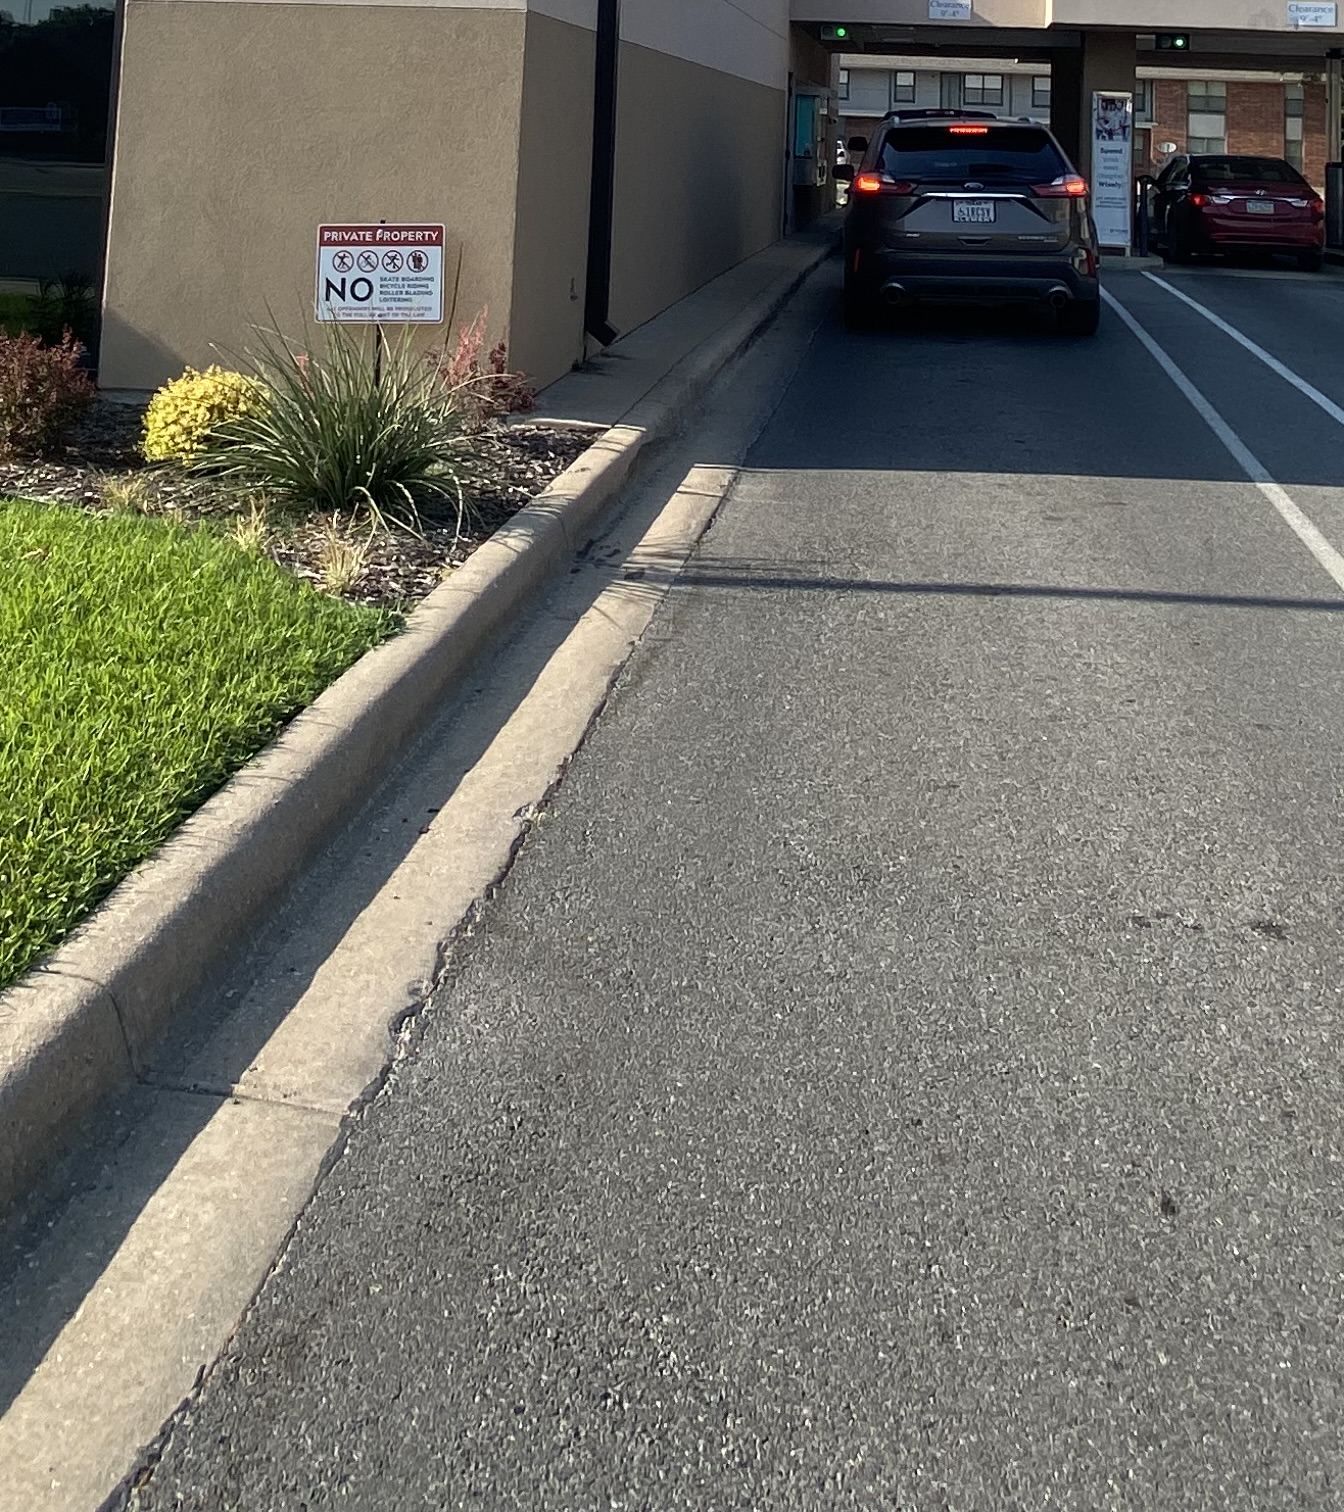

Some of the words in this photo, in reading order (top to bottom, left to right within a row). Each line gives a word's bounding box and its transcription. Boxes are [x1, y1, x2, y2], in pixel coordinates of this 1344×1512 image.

[930, 0, 970, 9] Clearance
[1288, 3, 1334, 13] Clearance
[323, 231, 373, 241] PRIVATE
[376, 230, 439, 241] PROPERTY
[325, 277, 374, 302] NO
